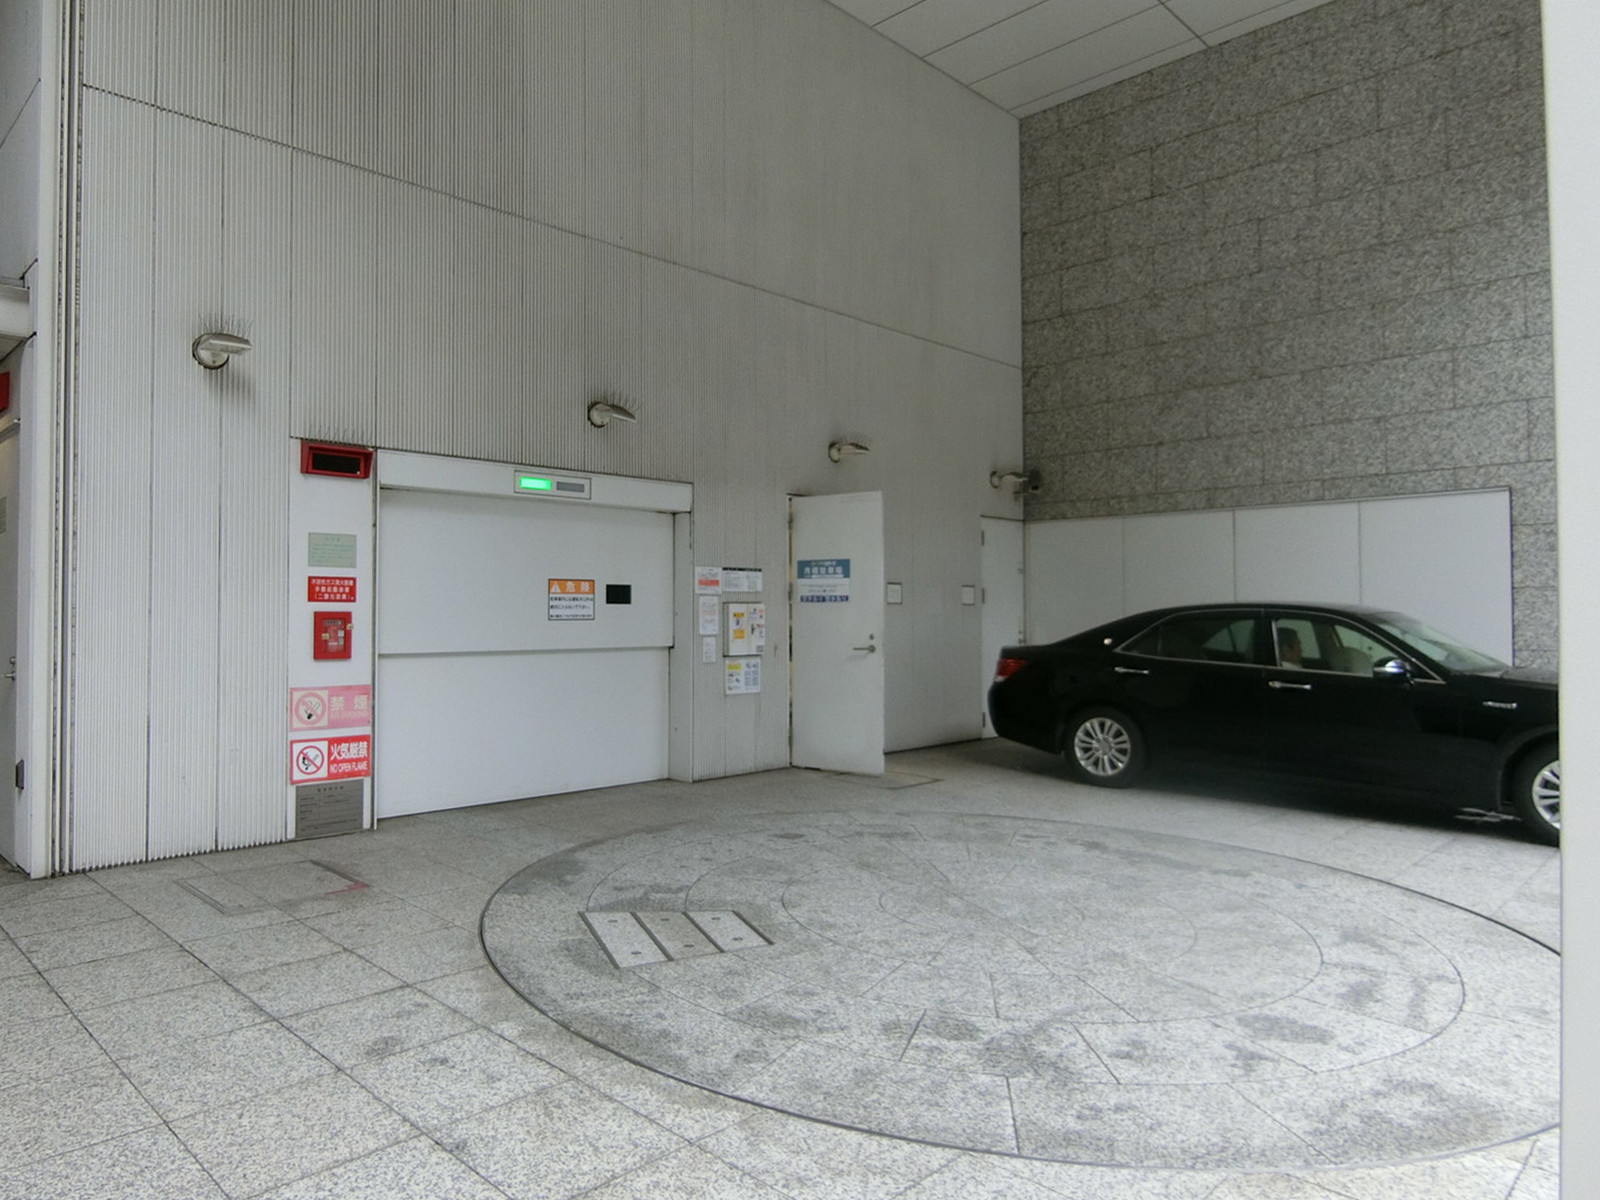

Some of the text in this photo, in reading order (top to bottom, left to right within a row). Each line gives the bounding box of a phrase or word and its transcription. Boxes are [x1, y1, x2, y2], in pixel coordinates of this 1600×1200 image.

[330, 694, 369, 711] 禁煙
[330, 741, 369, 761] 火気厳禁
[329, 760, 369, 774] NO OPEN FLAME
